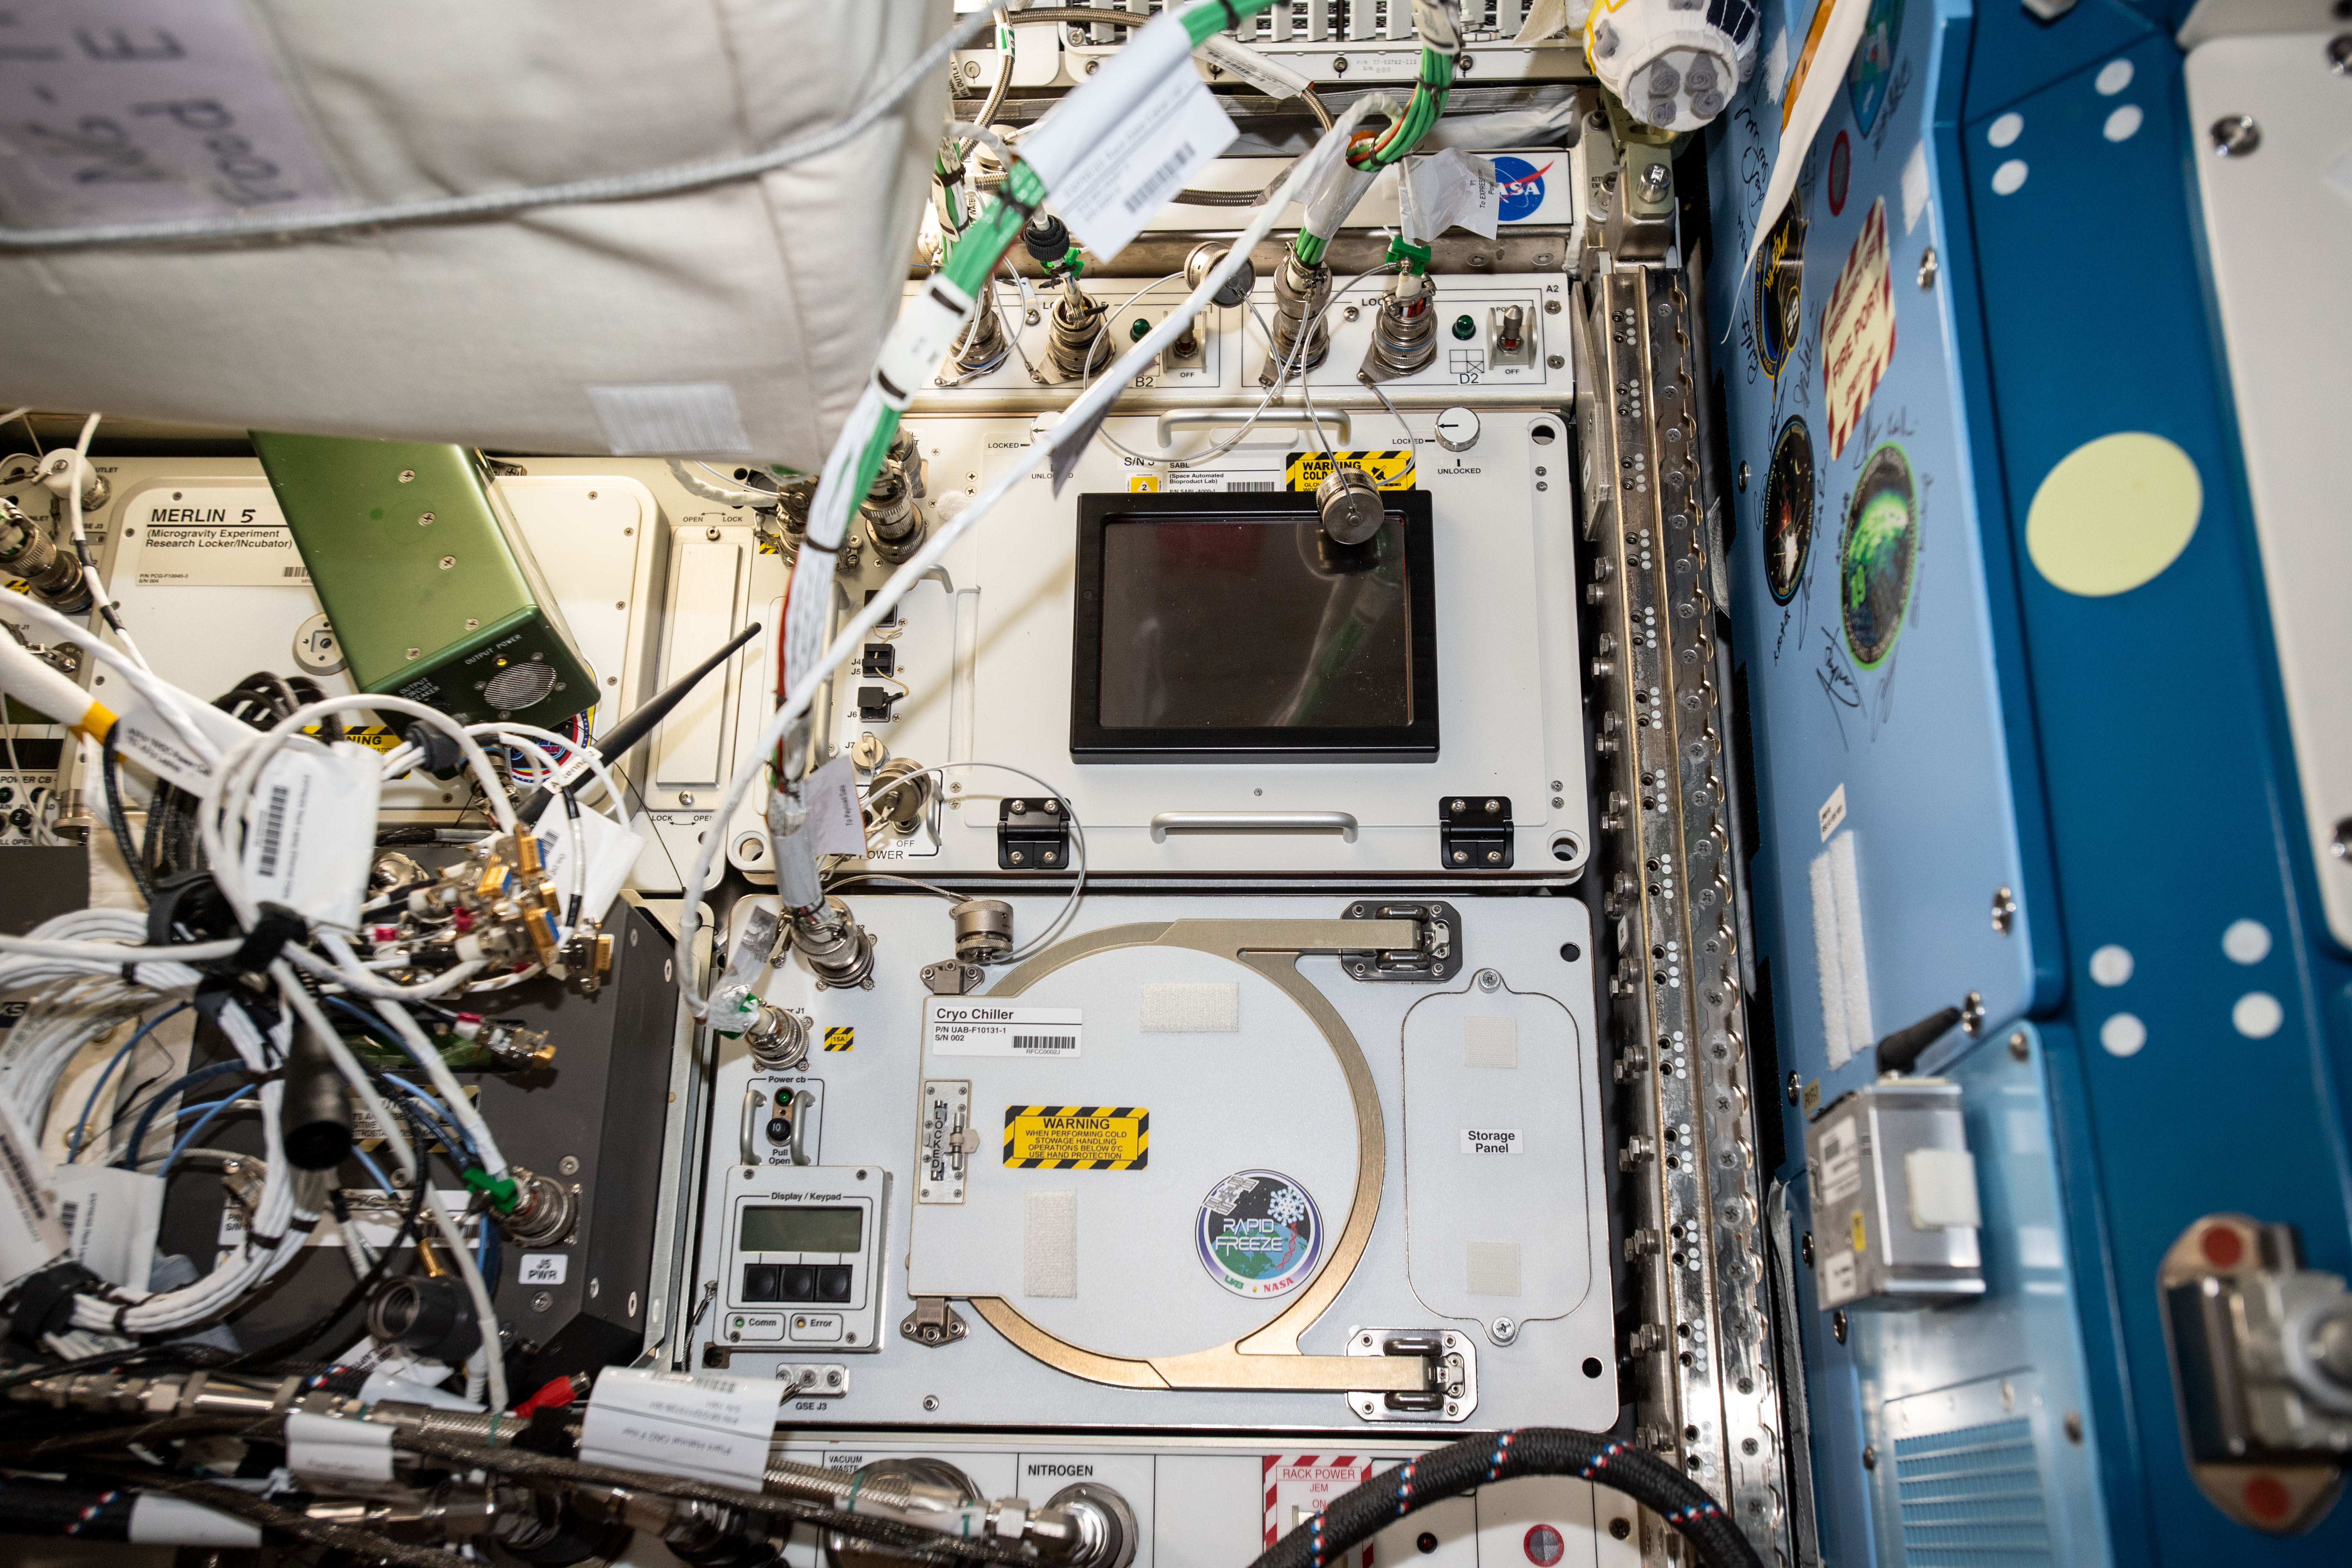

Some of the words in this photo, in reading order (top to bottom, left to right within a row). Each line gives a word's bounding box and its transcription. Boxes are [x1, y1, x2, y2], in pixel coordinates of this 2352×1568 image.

[1833, 332, 1854, 387] FIRE
[1854, 275, 1880, 345] PORT
[1135, 377, 1154, 387] B2
[1459, 373, 1479, 384] D2
[1124, 457, 1144, 466] S/N
[1303, 471, 1327, 480] COLD
[151, 509, 226, 522] MERLIN
[240, 509, 256, 523] 5
[147, 529, 217, 539] (Microgravity
[220, 530, 280, 539] Experiment
[145, 539, 195, 547] Research
[198, 539, 292, 549] Locker/INcubator)
[465, 648, 494, 666] OUTPUT
[495, 634, 523, 650] POWER
[398, 677, 429, 694] OUTPUT
[842, 797, 852, 817] Payload
[14, 812, 22, 820] 2
[844, 818, 853, 826] To
[936, 1008, 967, 1021] Cryo
[971, 1009, 1014, 1020] Chiller
[772, 1123, 781, 1132] 10
[1043, 1118, 1110, 1130] WARNING
[932, 1110, 943, 1169] LOCKED
[1468, 1130, 1515, 1143] Storage
[1475, 1143, 1509, 1153] Panel
[768, 1157, 790, 1165] Open
[771, 1192, 803, 1202] Display
[809, 1193, 842, 1202] Keypad
[1223, 1218, 1275, 1236] RAPID
[1215, 1236, 1282, 1258] FREEZE
[528, 1269, 558, 1280] PWR
[1263, 1277, 1294, 1293] NASA
[749, 1318, 776, 1326] Comm
[810, 1319, 832, 1327] Error
[795, 1402, 814, 1410] GSE
[816, 1402, 827, 1410] J3
[831, 1465, 858, 1473] WASTE
[1028, 1465, 1093, 1476] NITROGEN
[1283, 1468, 1312, 1479] RACK
[1315, 1468, 1355, 1479] POWER
[1309, 1484, 1328, 1492] JEM
[1312, 1500, 1328, 1509] ON
